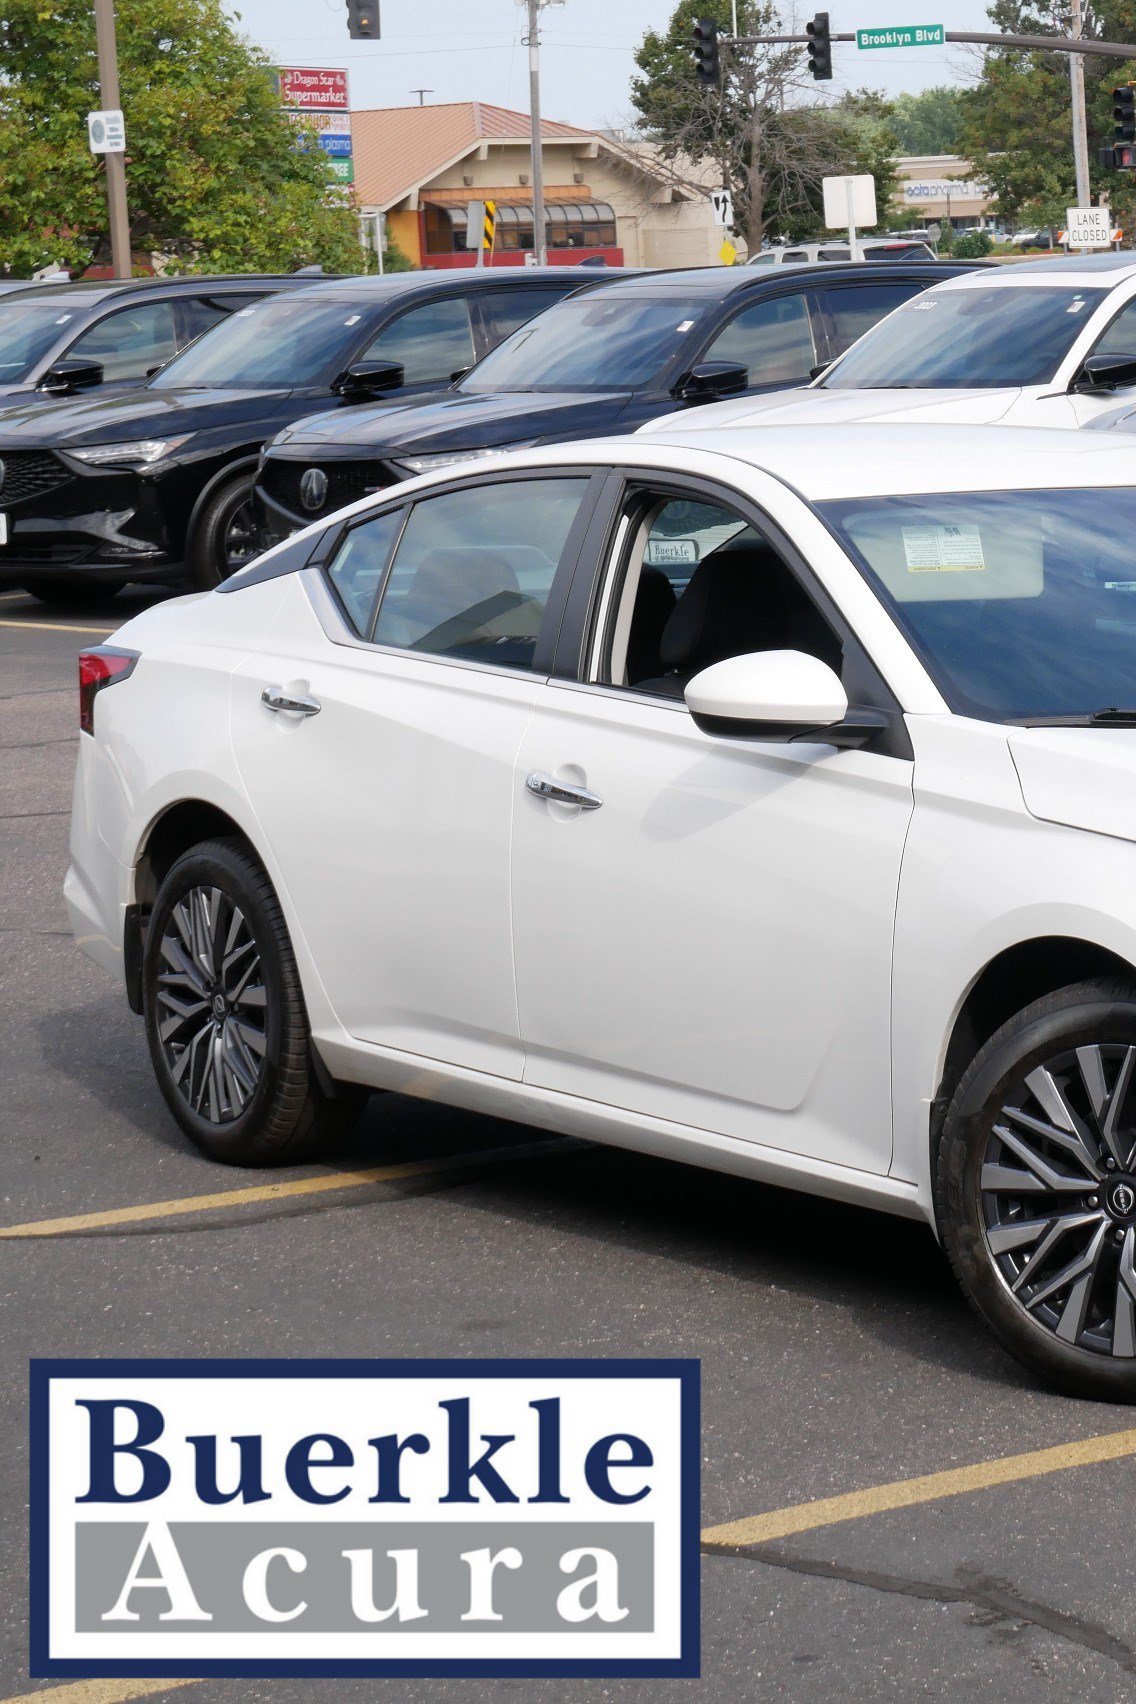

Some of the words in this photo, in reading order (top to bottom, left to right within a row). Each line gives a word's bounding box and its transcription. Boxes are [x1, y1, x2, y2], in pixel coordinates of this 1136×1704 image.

[861, 32, 911, 45] Brooklyn
[915, 29, 941, 42] Blvd
[293, 71, 319, 87] Dragon
[320, 73, 335, 85] Star
[284, 84, 346, 103] Supermarket
[1077, 213, 1100, 225] LANE
[1072, 229, 1107, 242] CLOSED
[654, 544, 690, 556] Buerkle
